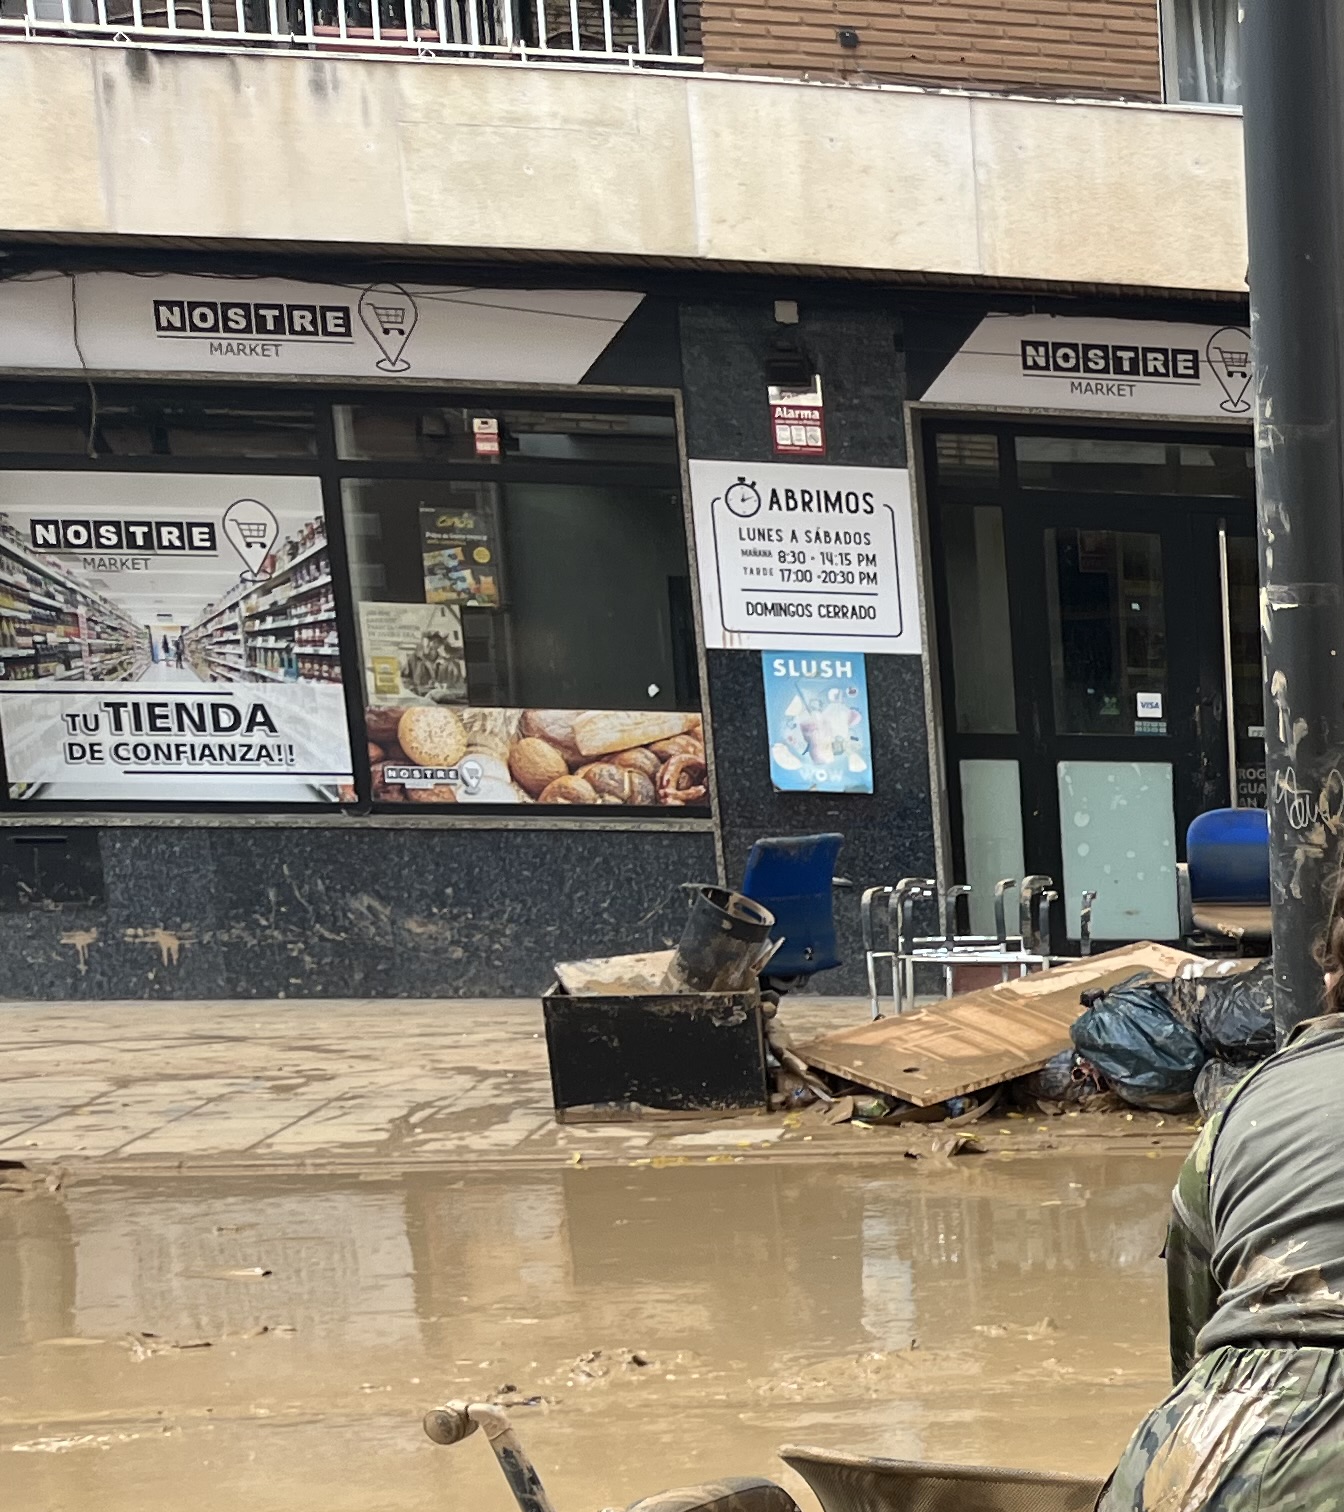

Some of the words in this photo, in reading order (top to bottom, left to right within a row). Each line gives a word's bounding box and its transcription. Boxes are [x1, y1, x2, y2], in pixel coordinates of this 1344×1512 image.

[157, 304, 348, 333] NOSTRE
[209, 342, 283, 357] MARKET
[1024, 344, 1197, 376] NOSTRE
[1070, 381, 1136, 397] MARKET
[774, 406, 820, 419] Alarma
[768, 487, 874, 515] ABRIMOS
[33, 523, 212, 549] NOSTRE
[738, 527, 783, 543] LUNES
[790, 529, 798, 543] A
[804, 527, 871, 545] SÁBADOS
[83, 557, 151, 570] MARKET
[778, 550, 806, 564] 8:30
[819, 551, 852, 566] 14:15
[857, 553, 877, 567] PM
[779, 568, 813, 583] 17:00
[859, 571, 878, 585] PM
[746, 601, 813, 618] DOMINGOS
[817, 603, 876, 620] CERRADO
[773, 658, 853, 678] SLUSH
[1141, 701, 1160, 709] VISA
[65, 713, 100, 732] TU
[103, 701, 278, 733] TIENDA
[67, 742, 104, 761] DE
[113, 742, 296, 763] CONFIANZA!!
[386, 768, 458, 780] NOSTRE
